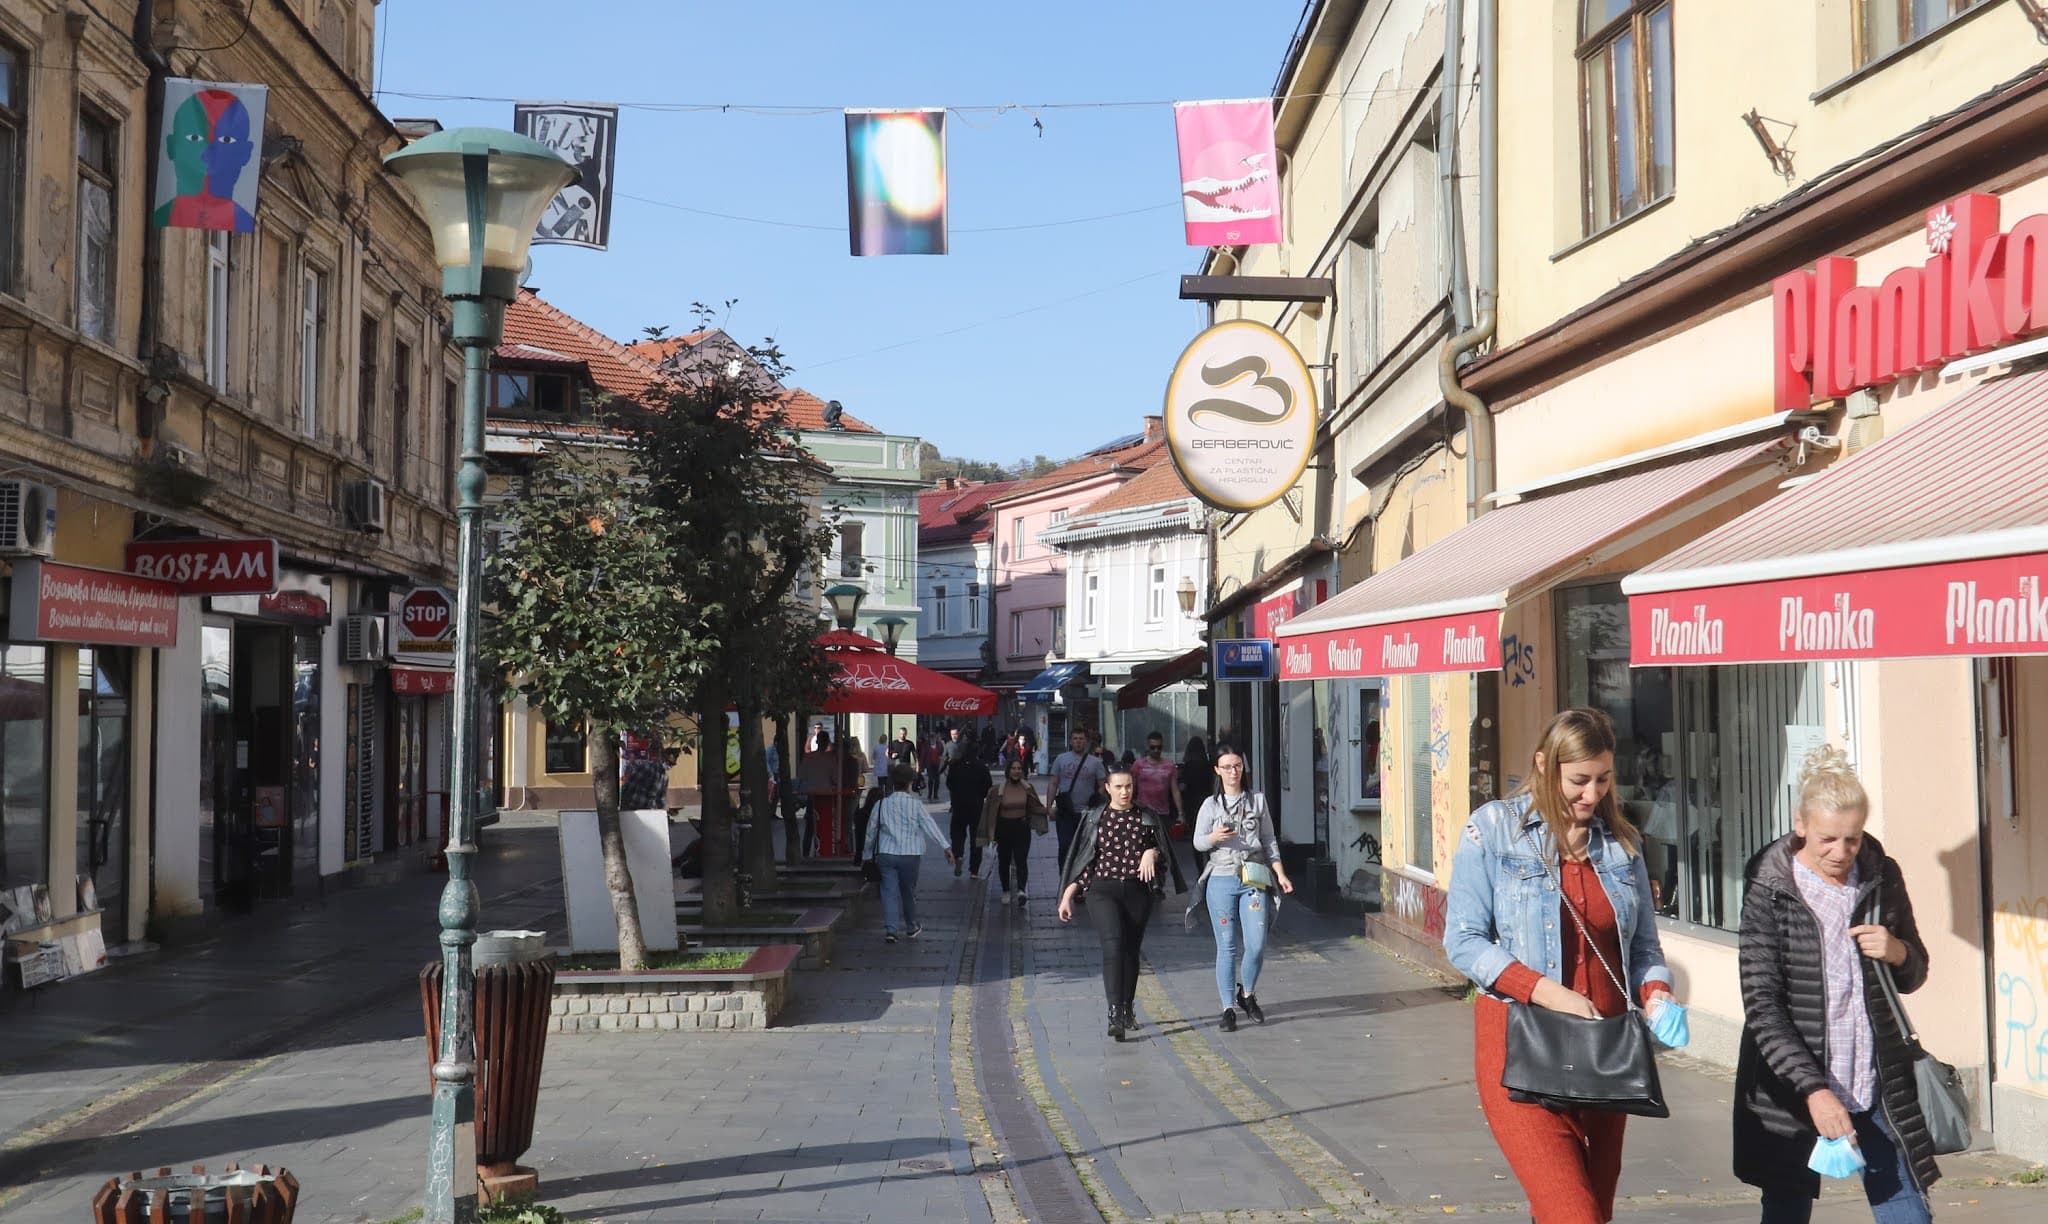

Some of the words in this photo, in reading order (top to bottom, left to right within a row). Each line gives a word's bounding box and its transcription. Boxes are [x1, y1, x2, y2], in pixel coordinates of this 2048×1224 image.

[1773, 193, 2048, 411] Planika
[1209, 466, 1223, 474] ZA
[1224, 457, 1263, 465] CENTAR
[135, 552, 267, 583] BOSFAM
[139, 616, 153, 633] and
[405, 605, 447, 622] STOP
[1779, 593, 1874, 652] Planika
[1443, 625, 1486, 664] Planika
[1651, 604, 1724, 657] Planika
[1328, 639, 1362, 672] Planika
[1382, 633, 1419, 669] Planika
